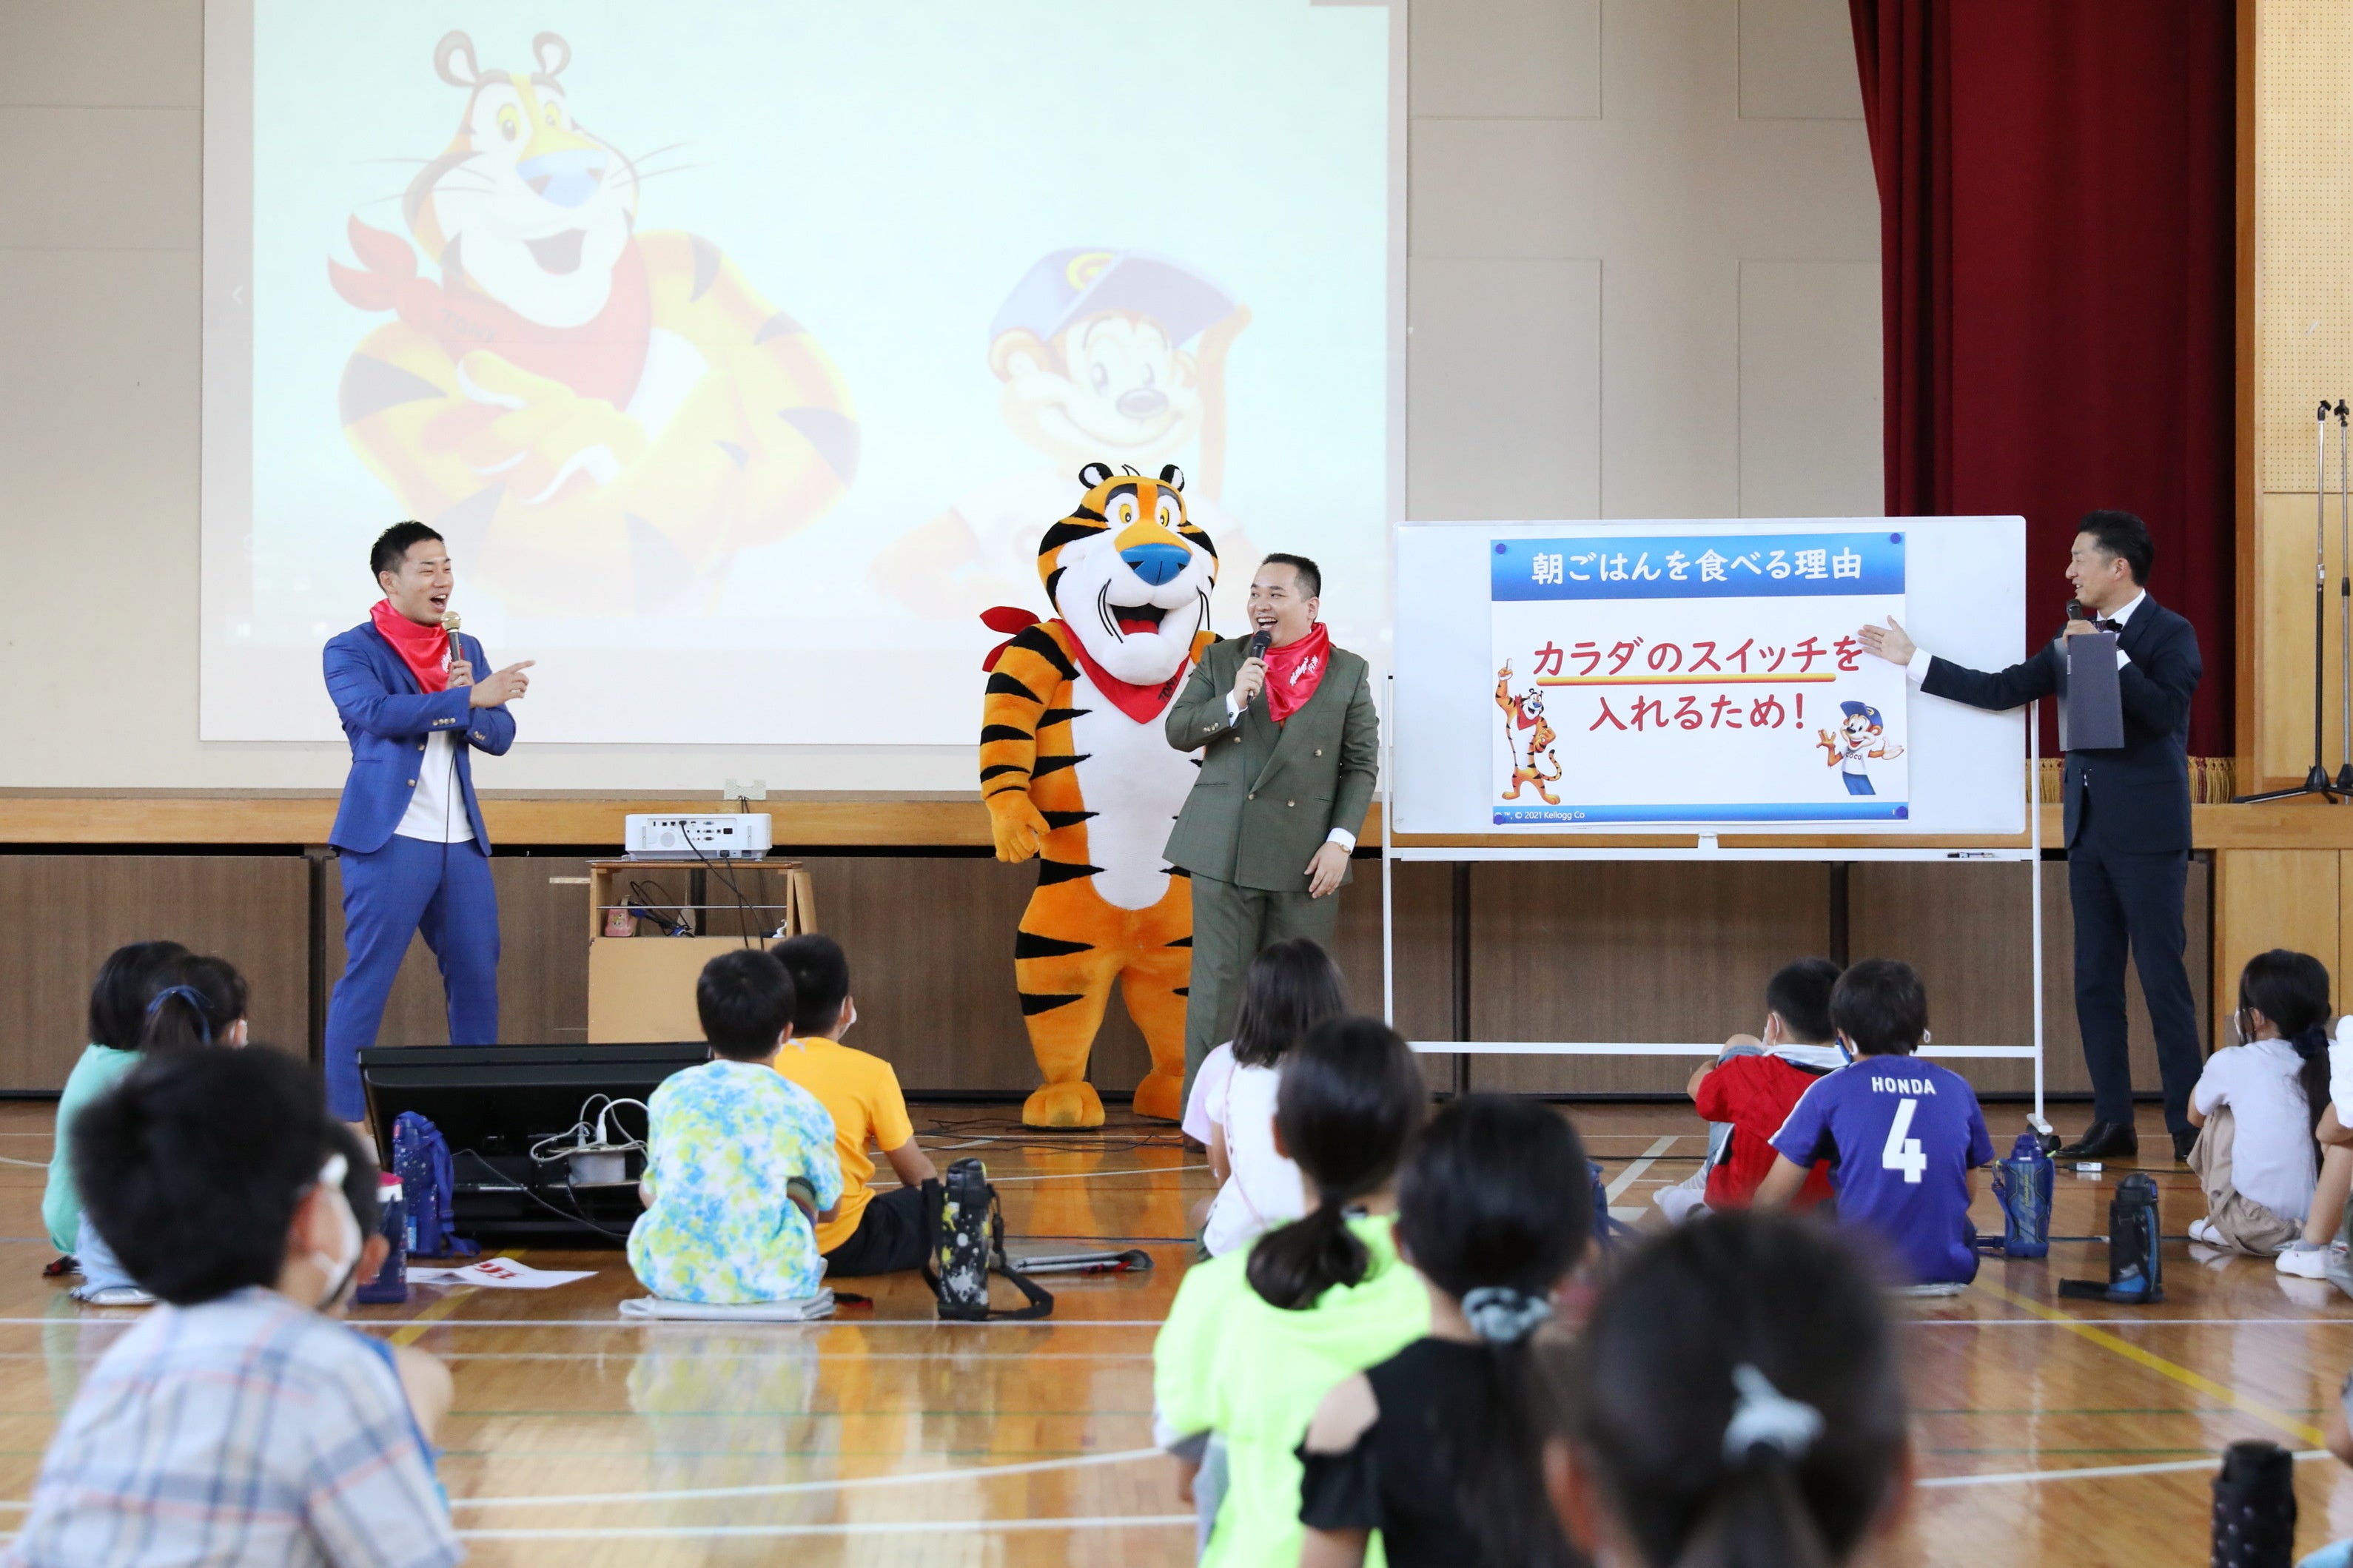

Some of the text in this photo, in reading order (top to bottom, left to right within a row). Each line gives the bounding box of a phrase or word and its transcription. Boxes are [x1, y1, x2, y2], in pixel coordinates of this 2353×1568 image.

[1531, 547, 1862, 585] 朝ごはんを食べる理由
[1533, 635, 1863, 676] カラダのスイッチを
[1846, 752, 1862, 761] COCO
[1525, 811, 1542, 819] 2021
[1544, 811, 1572, 821] Kellogg
[1574, 810, 1585, 818] Co
[1871, 1076, 1936, 1095] HONDA
[1882, 1098, 1927, 1183] 4
